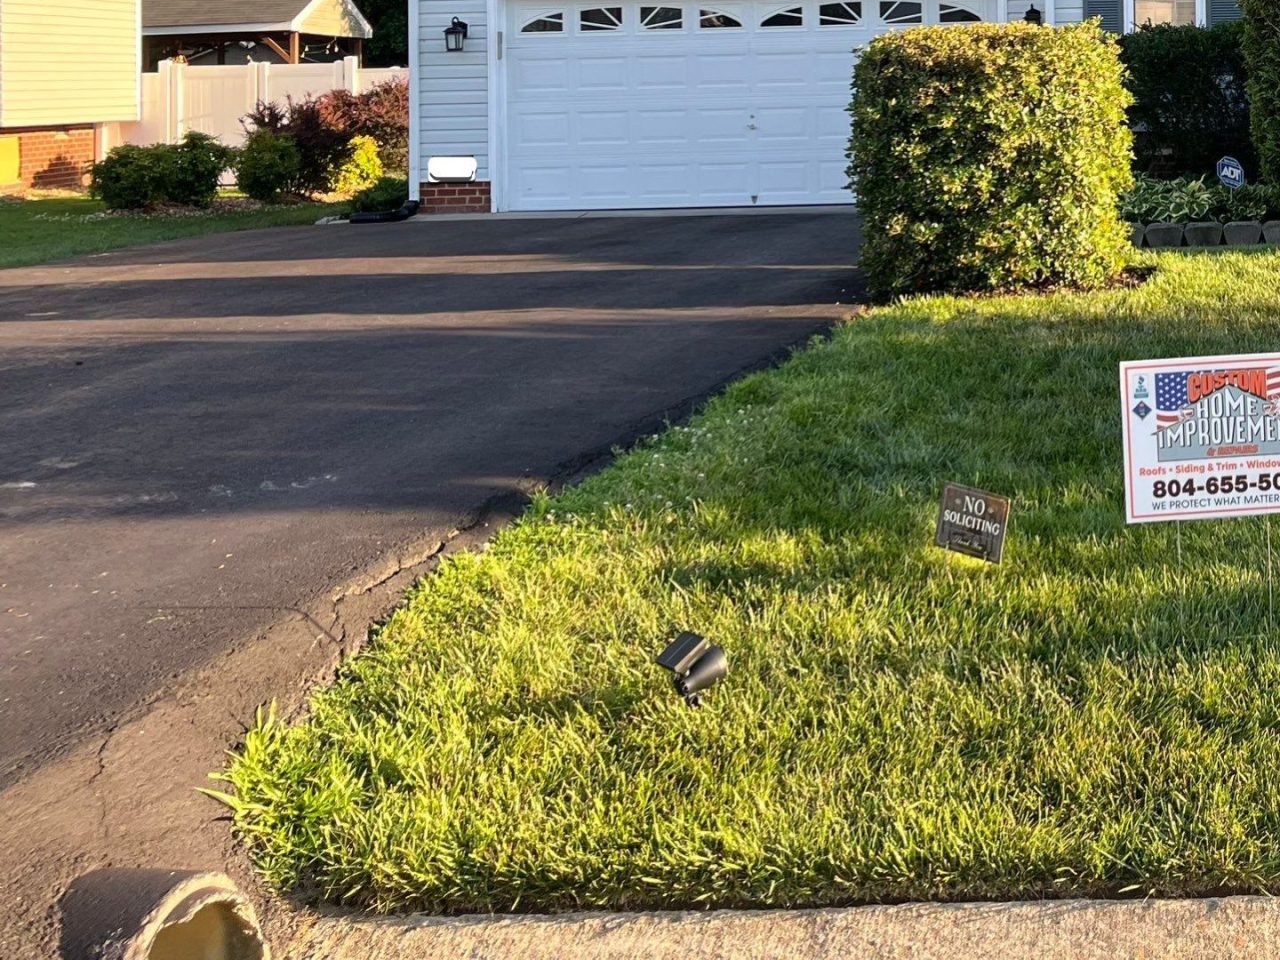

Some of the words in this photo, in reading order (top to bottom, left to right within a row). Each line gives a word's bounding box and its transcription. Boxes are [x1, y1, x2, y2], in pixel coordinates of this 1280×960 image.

[1220, 166, 1241, 180] ADT
[1187, 369, 1268, 404] CUSTOM
[1197, 388, 1259, 419] HOME
[1139, 465, 1167, 476] Roofs
[1175, 462, 1205, 475] Siding
[1207, 462, 1214, 472] &
[1215, 460, 1237, 471] Trim
[963, 495, 985, 516] NO
[1152, 501, 1167, 511] WE
[1169, 498, 1211, 510] PROTECT
[1214, 496, 1241, 507] WHAT
[944, 509, 1000, 535] SOLICITING
